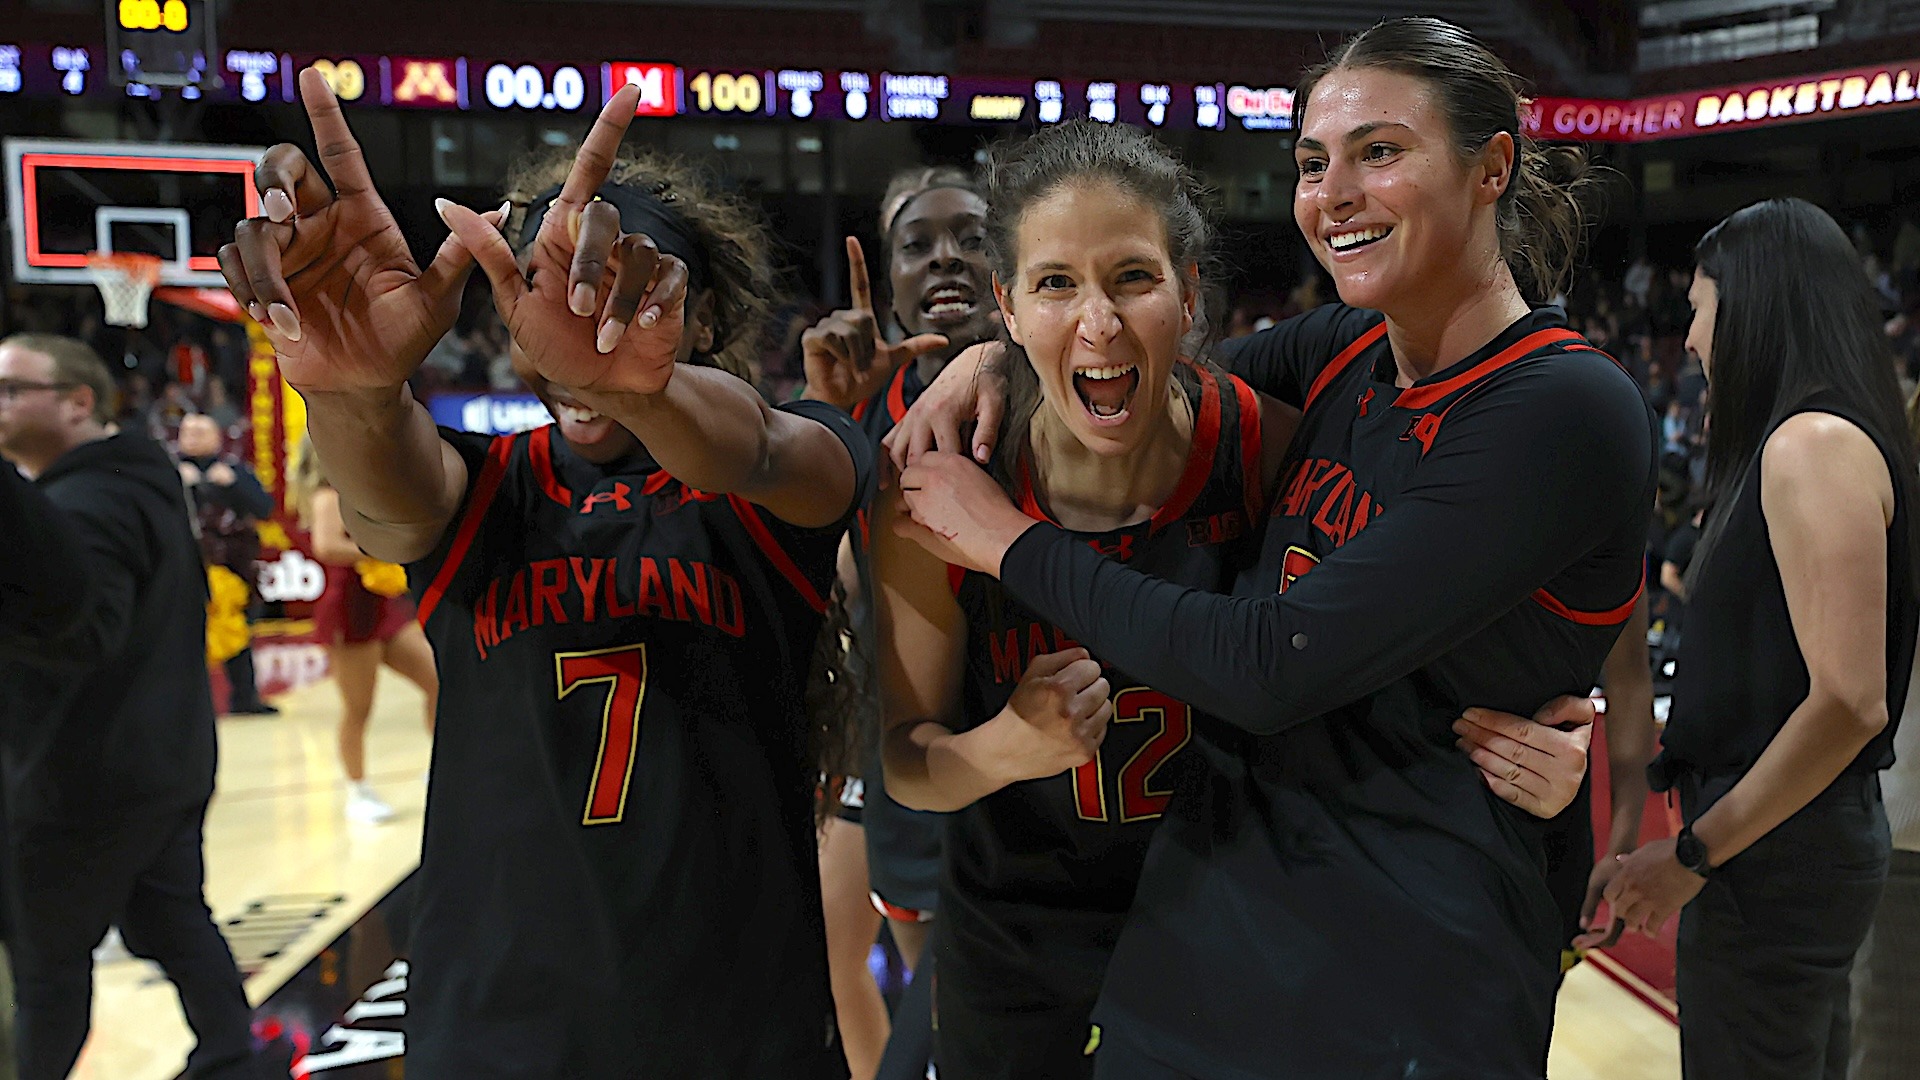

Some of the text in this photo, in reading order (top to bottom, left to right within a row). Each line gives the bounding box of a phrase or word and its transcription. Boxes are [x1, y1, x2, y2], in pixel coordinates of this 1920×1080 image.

[486, 63, 584, 109] 00.0
[690, 71, 761, 112] 100
[1553, 101, 1686, 135] GOPHER
[473, 556, 746, 661] MARYLAND
[555, 643, 648, 826] 7
